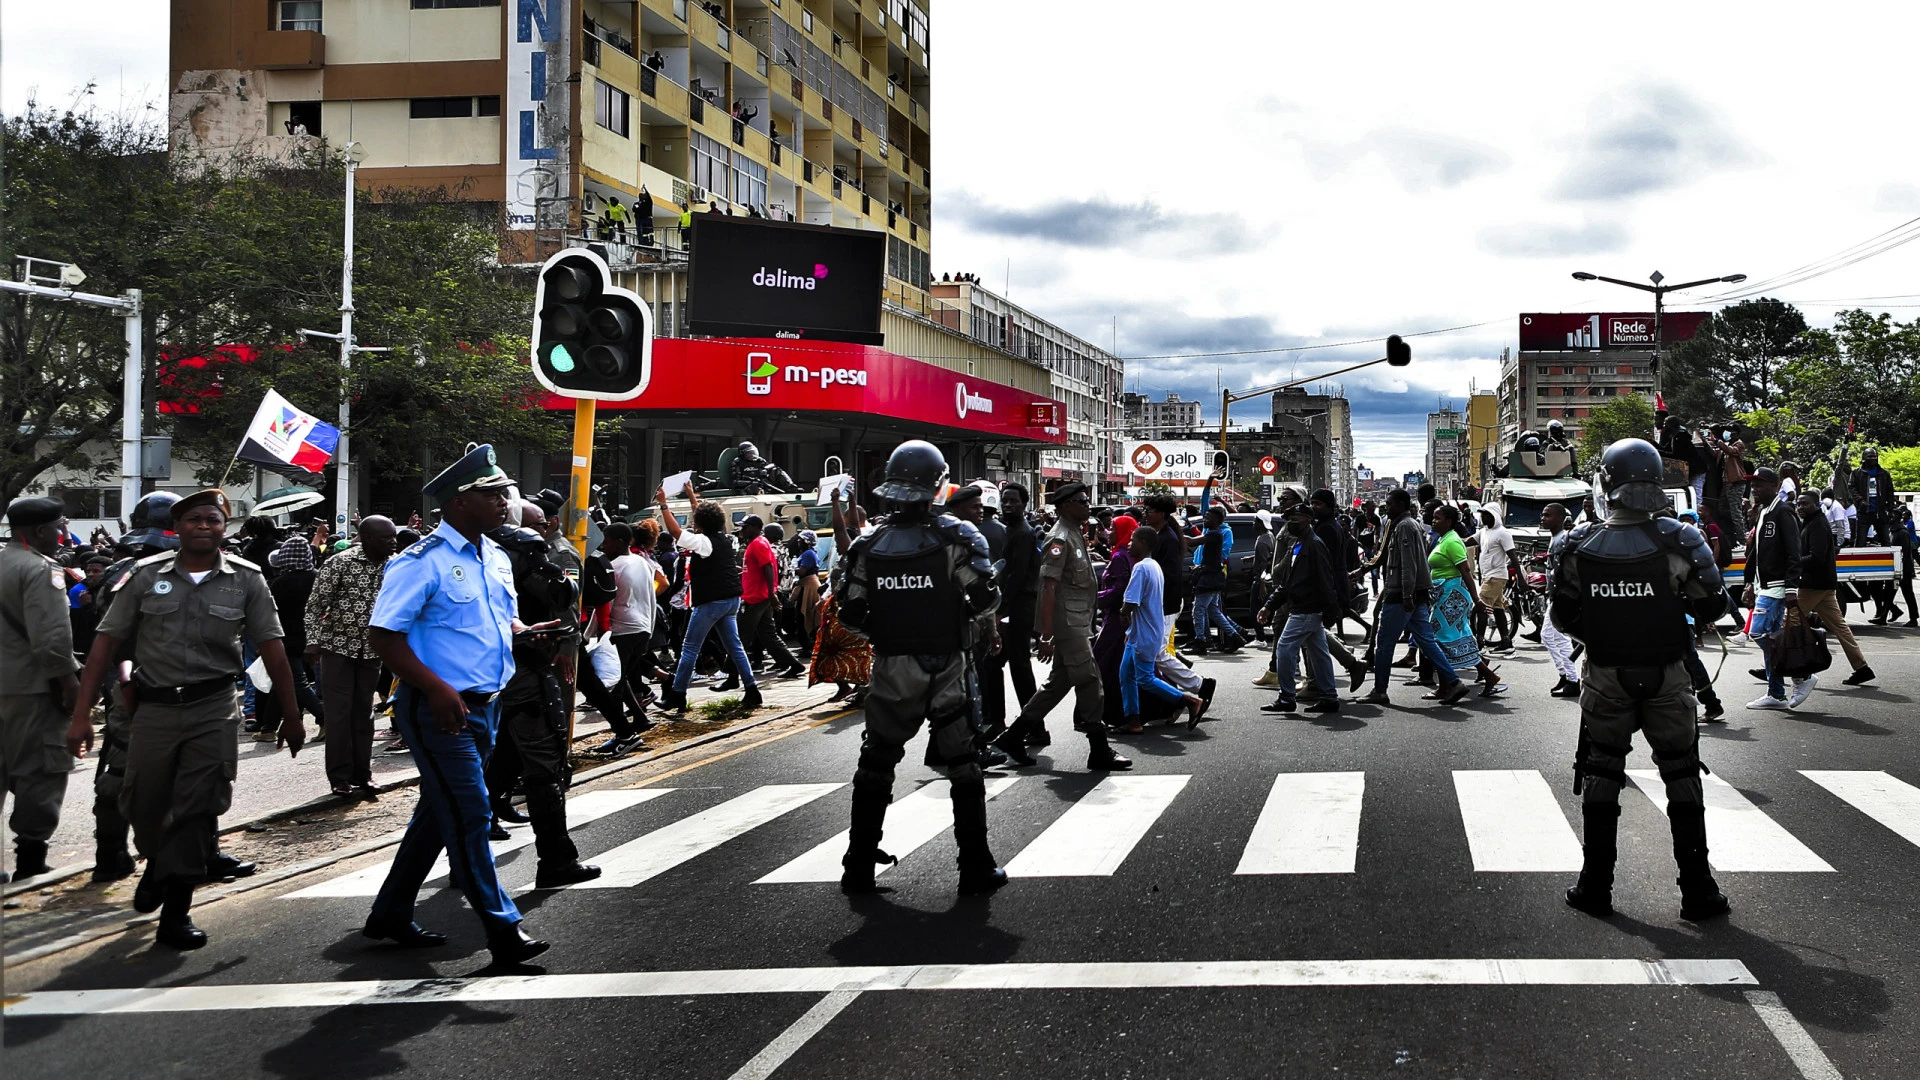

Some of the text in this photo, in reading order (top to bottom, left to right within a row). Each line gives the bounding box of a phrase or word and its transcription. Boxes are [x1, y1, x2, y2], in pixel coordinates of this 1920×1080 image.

[752, 266, 816, 290] dalima
[1613, 321, 1646, 333] Rede
[775, 331, 800, 339] dalima
[1613, 333, 1648, 342] Número
[785, 365, 867, 389] m-pesa
[1165, 452, 1197, 467] galp
[1161, 469, 1201, 479] energia
[876, 573, 934, 590] POLÍCIA
[1590, 580, 1655, 598] POLÍCIA
